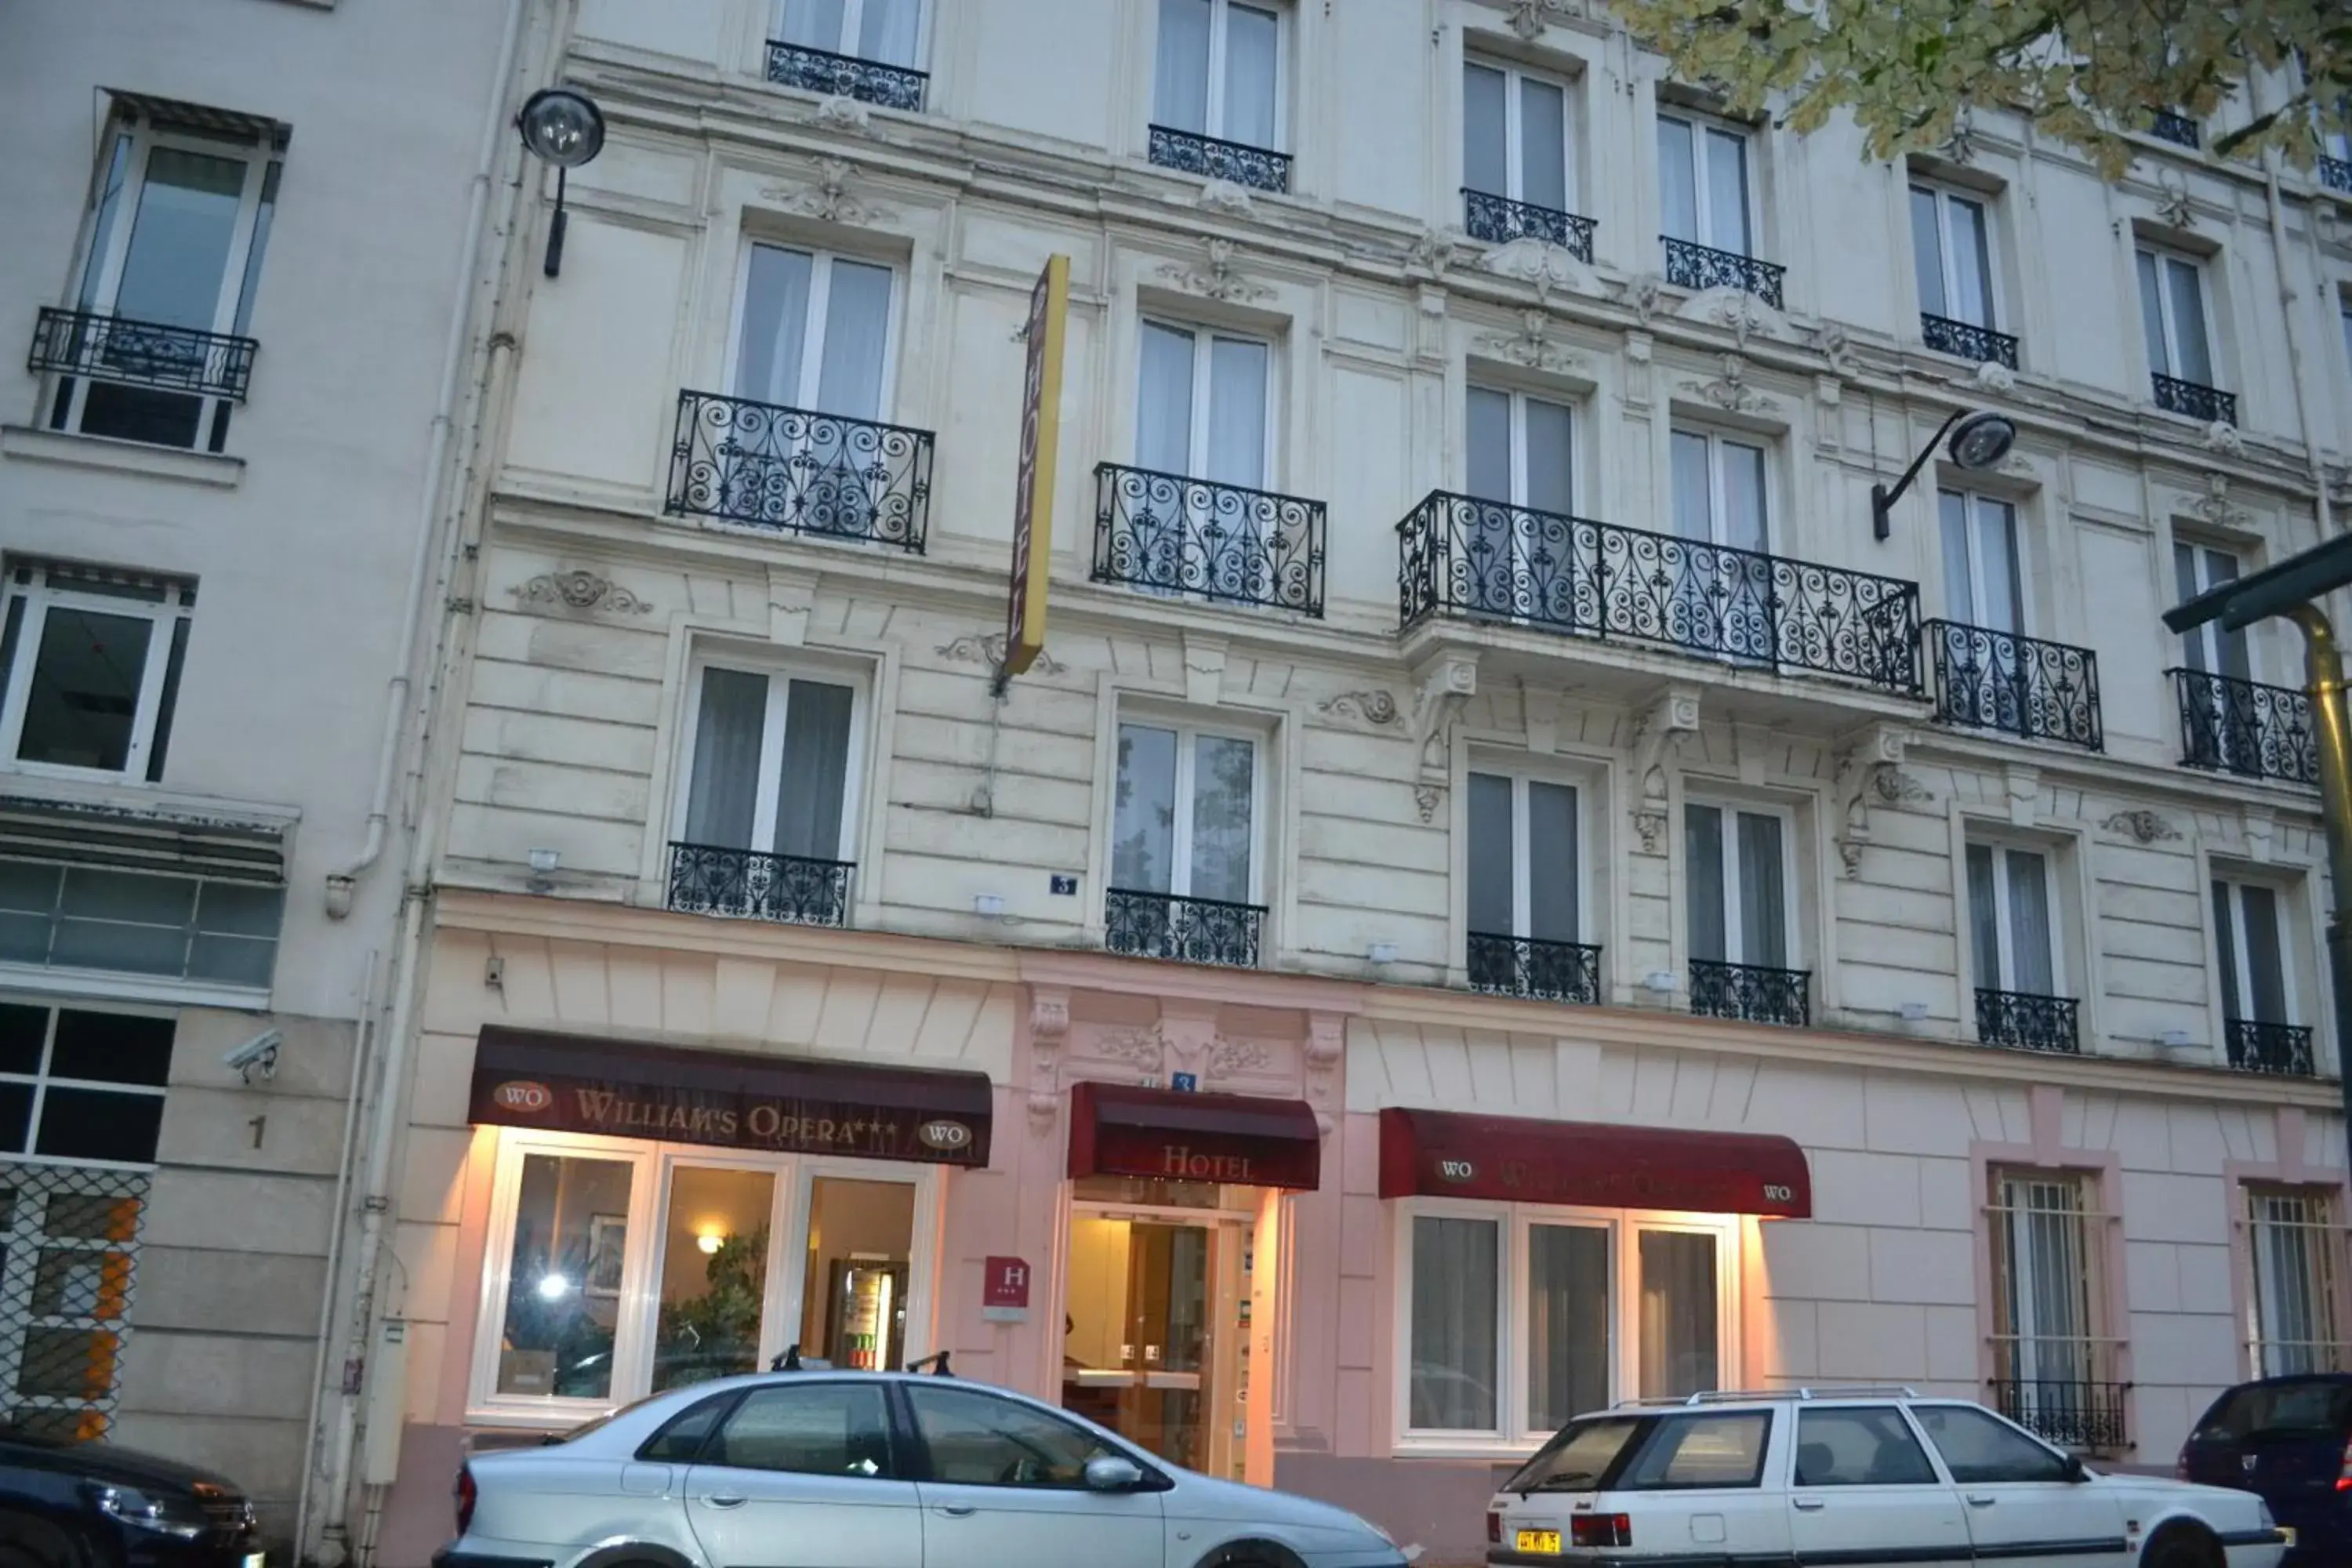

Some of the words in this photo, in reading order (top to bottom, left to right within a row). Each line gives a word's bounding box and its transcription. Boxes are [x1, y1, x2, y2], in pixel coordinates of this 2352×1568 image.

[1058, 877, 1069, 893] 3
[506, 1087, 543, 1107] WO
[249, 1114, 267, 1150] 1
[928, 1125, 964, 1144] WO
[1164, 1145, 1254, 1178] HOTEL
[1443, 1160, 1472, 1178] WO
[1764, 1185, 1791, 1201] WO
[1004, 1266, 1023, 1285] H
